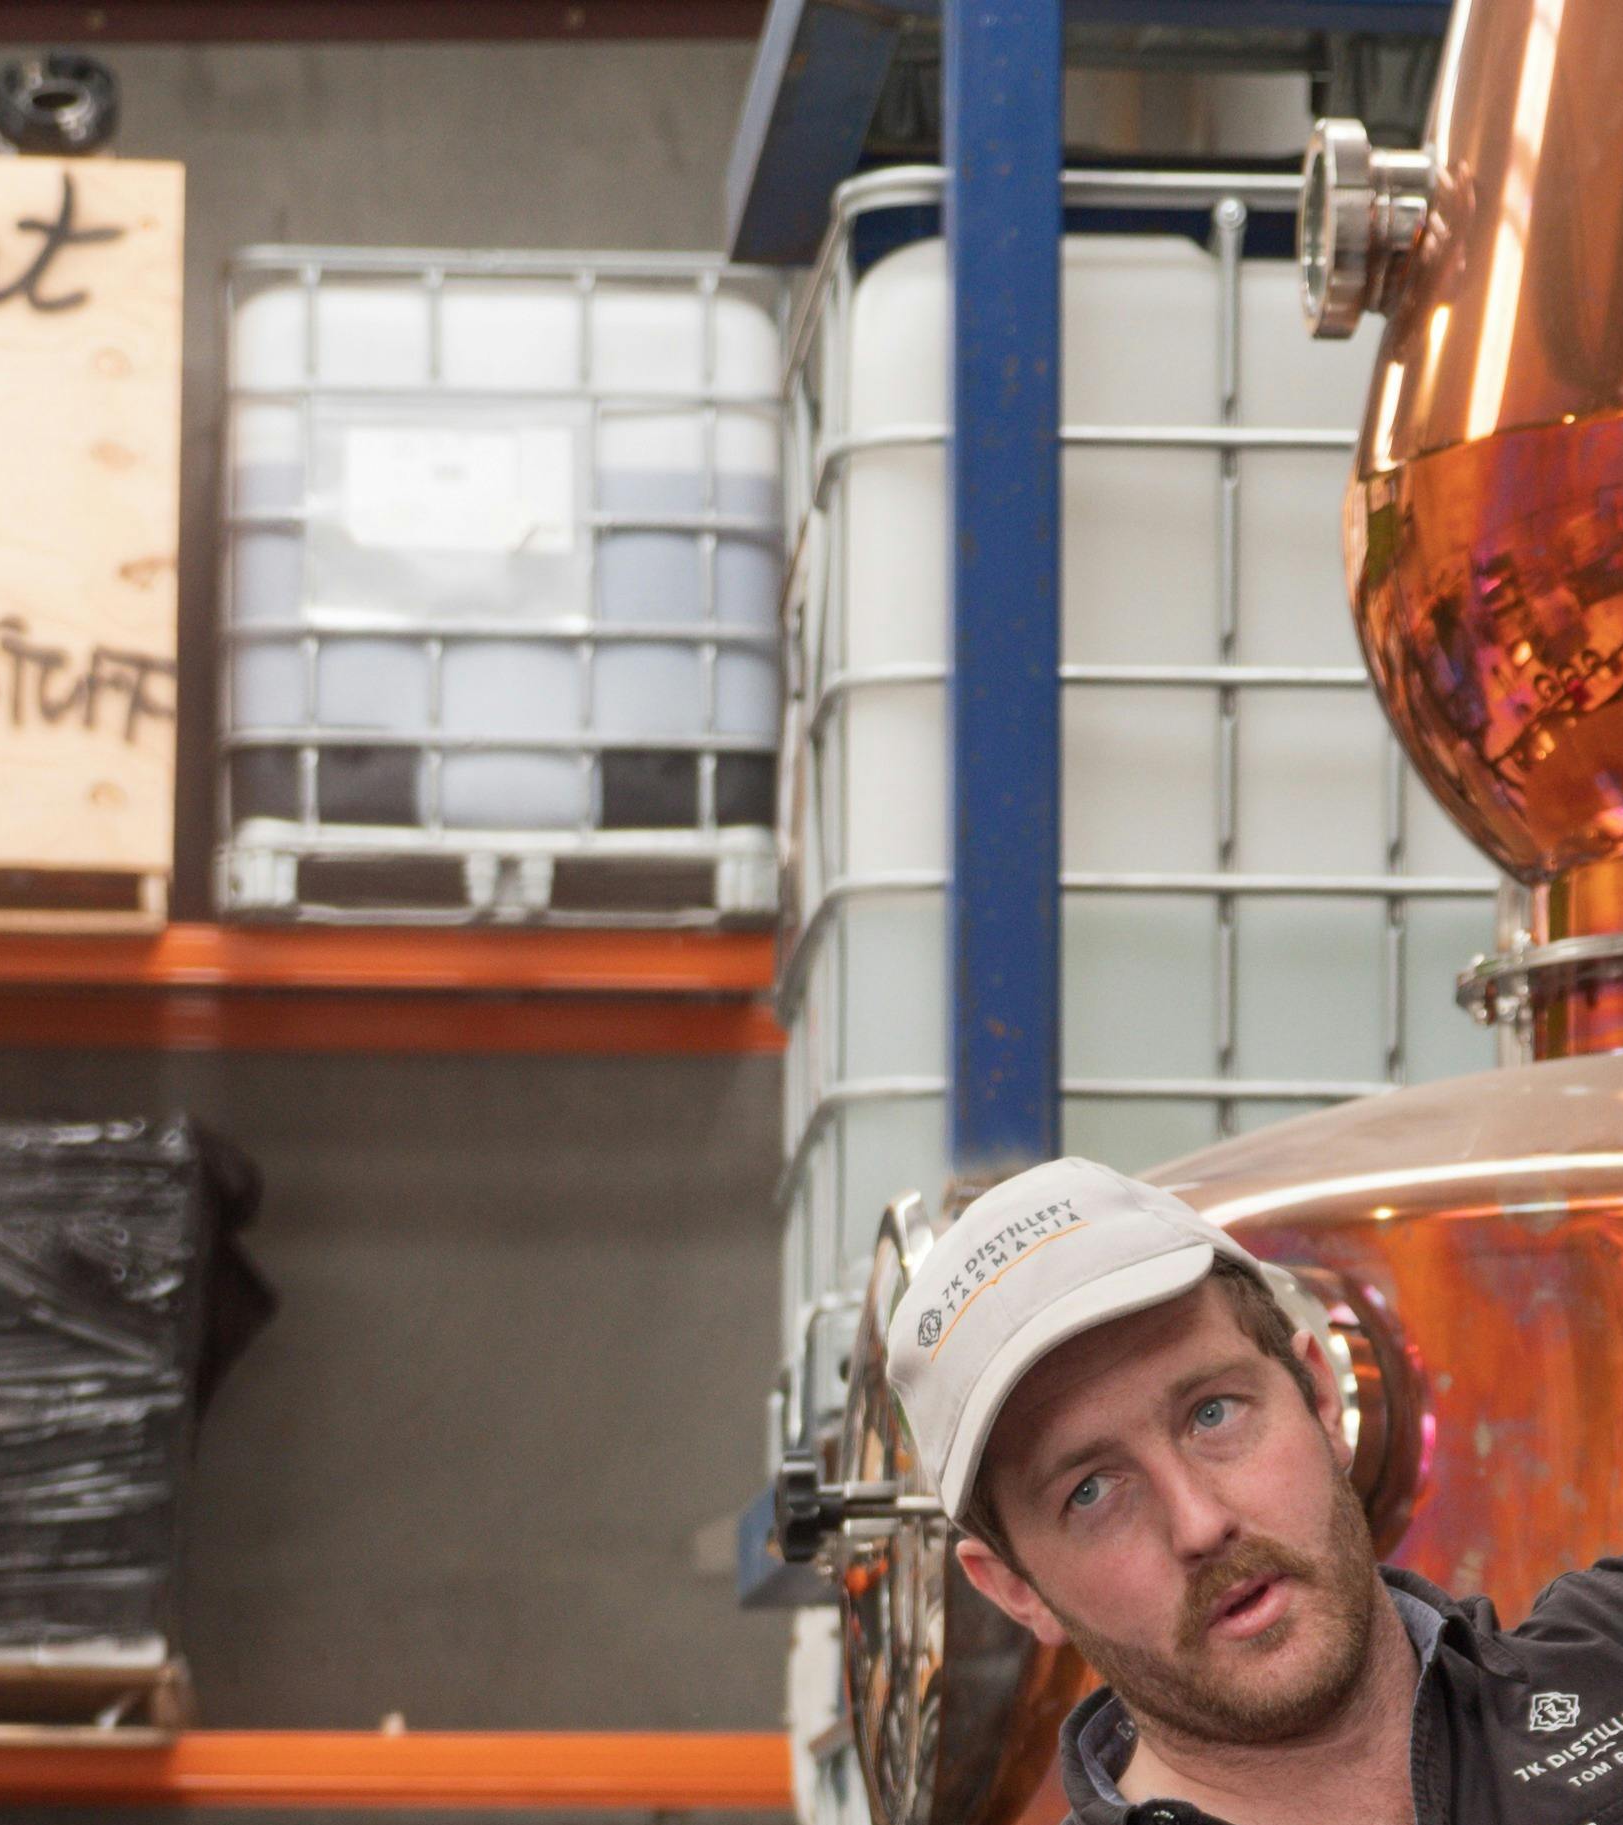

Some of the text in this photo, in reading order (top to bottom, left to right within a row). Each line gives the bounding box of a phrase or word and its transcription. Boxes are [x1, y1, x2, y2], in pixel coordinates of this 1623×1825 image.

[942, 1199, 1073, 1300] 7K DISTILLERY
[947, 1212, 1082, 1312] TASMANIA
[1514, 1761, 1548, 1782] 7K
[1568, 1760, 1613, 1787] TOM
